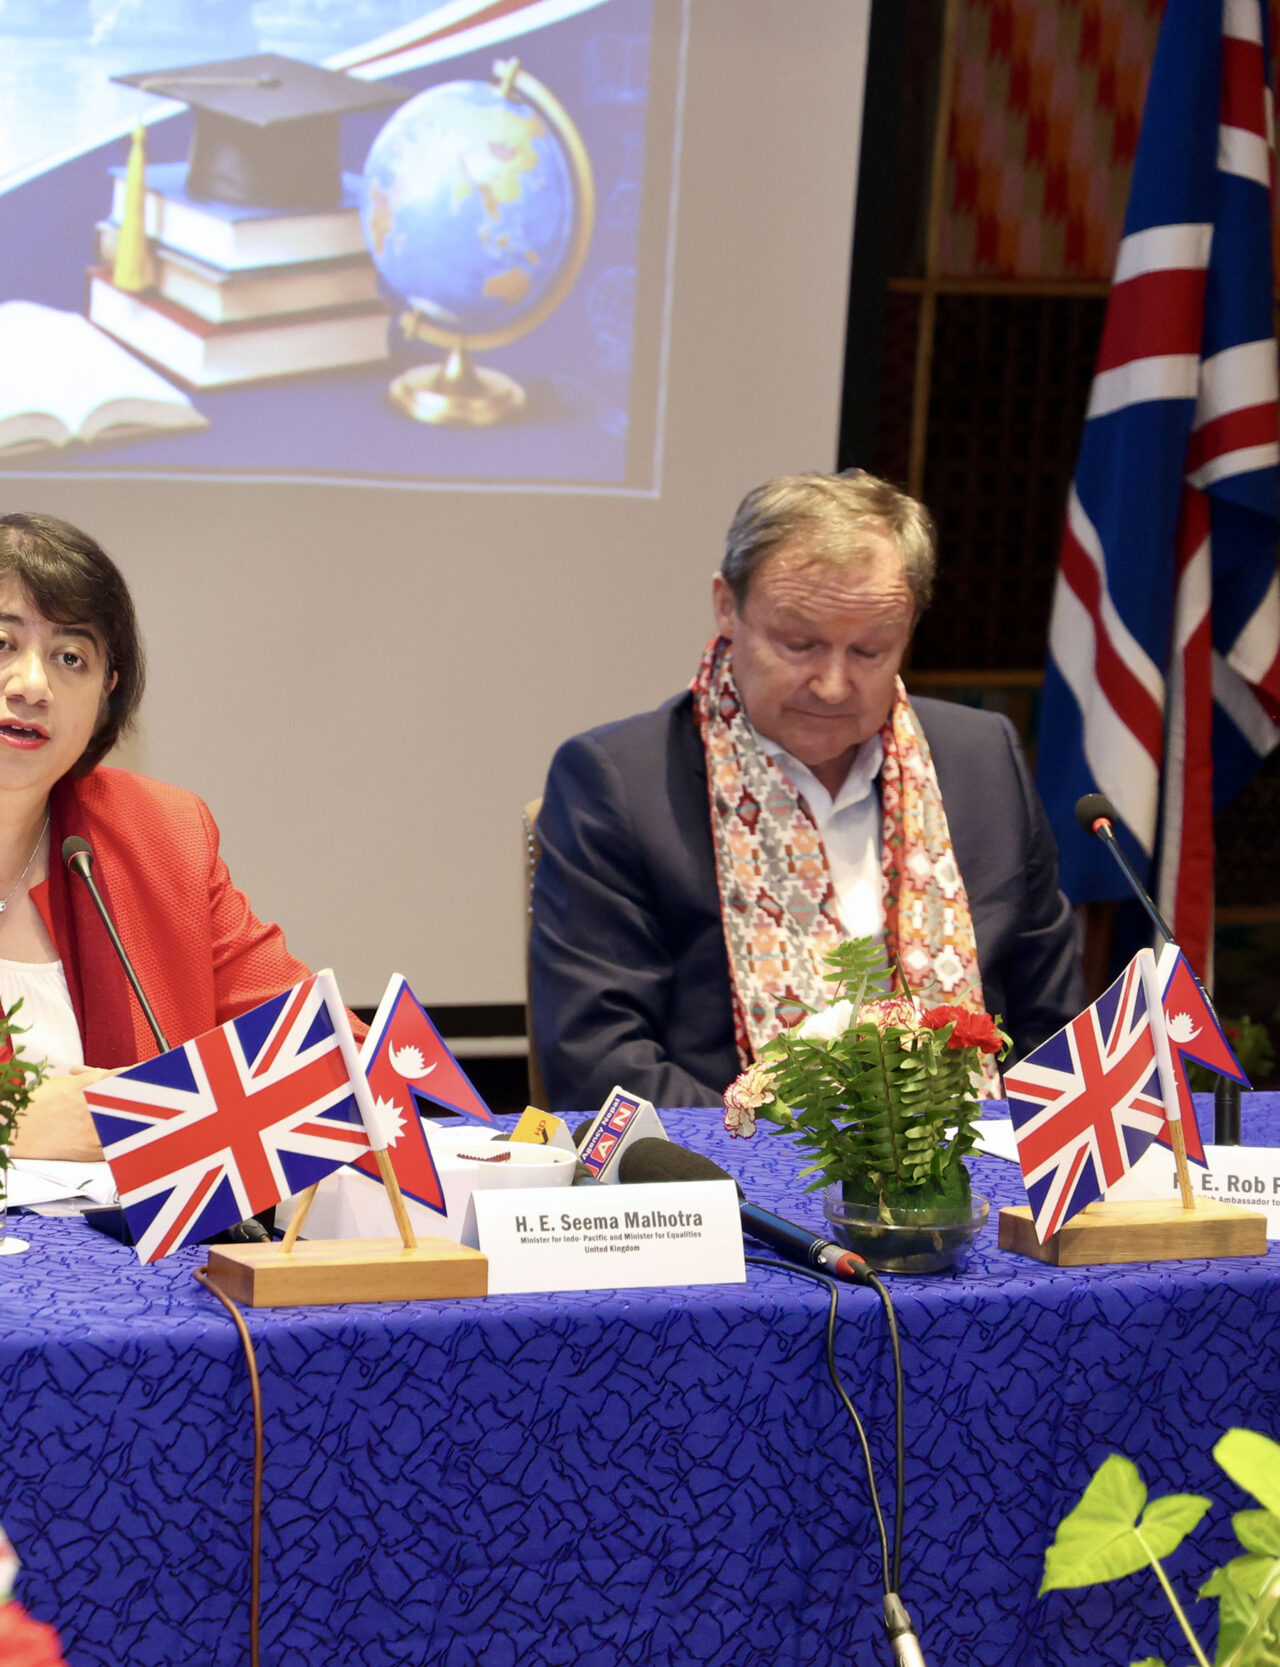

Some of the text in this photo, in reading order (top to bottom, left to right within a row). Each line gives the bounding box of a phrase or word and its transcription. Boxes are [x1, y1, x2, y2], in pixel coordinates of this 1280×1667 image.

[582, 1098, 620, 1161] Agency Nepal
[1201, 1173, 1219, 1191] E.
[1227, 1174, 1266, 1194] Rob
[1218, 1196, 1270, 1206] Ambassador
[515, 1210, 703, 1232] H. E. Seema Malhotra
[520, 1236, 550, 1244] Minister
[552, 1235, 561, 1243] for
[583, 1234, 608, 1242] Pacific
[609, 1233, 622, 1241] and
[624, 1232, 653, 1240] Minister
[655, 1231, 665, 1239] for
[666, 1230, 702, 1240] Equalities
[584, 1244, 640, 1253] United Kingdom
